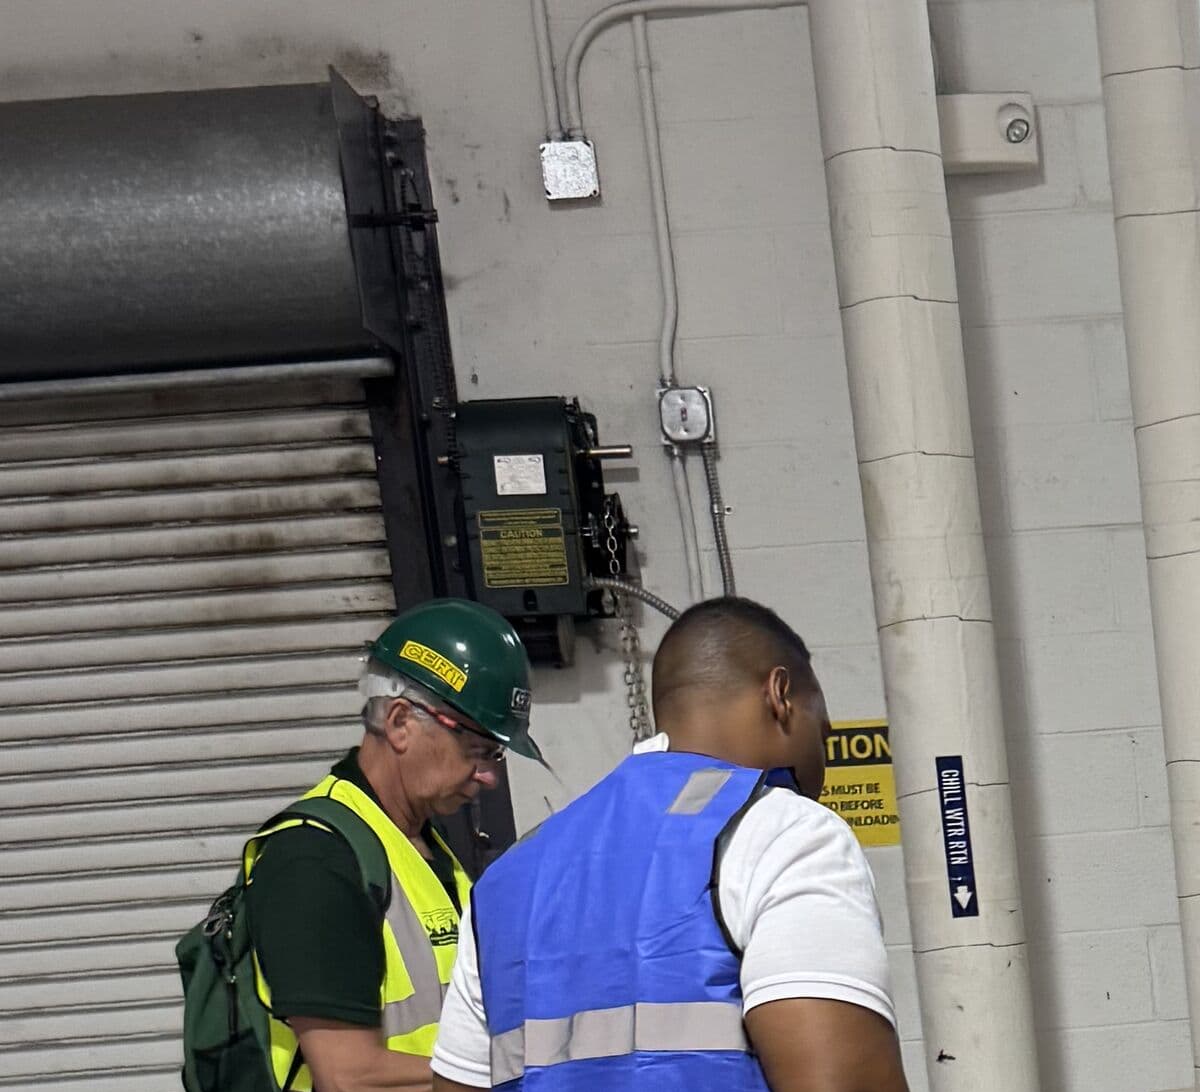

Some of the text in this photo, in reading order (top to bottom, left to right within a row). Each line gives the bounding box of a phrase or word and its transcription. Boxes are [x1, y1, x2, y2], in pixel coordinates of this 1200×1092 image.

[500, 528, 543, 540] CAUTION
[403, 643, 465, 686] CERT
[832, 784, 863, 797] MUST
[866, 782, 881, 794] BE
[840, 799, 884, 812] BEFORE
[941, 769, 969, 865] CHILL WTR RTN
